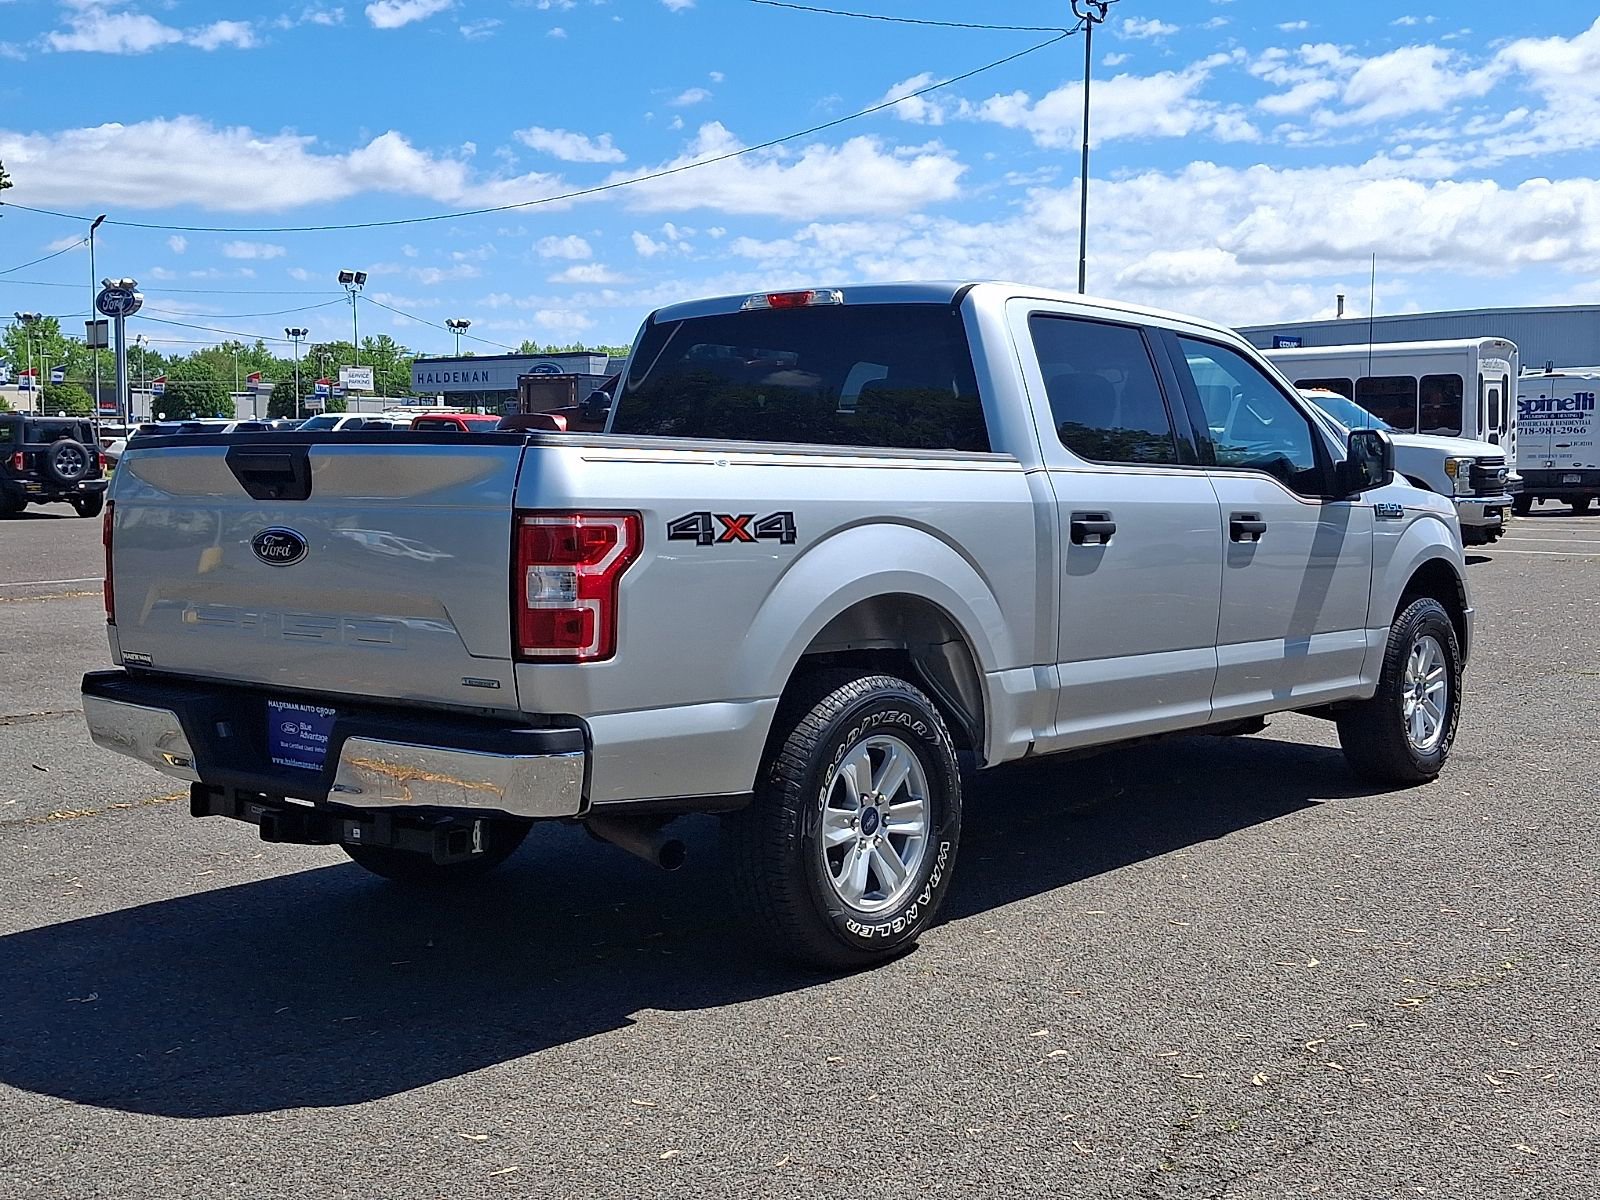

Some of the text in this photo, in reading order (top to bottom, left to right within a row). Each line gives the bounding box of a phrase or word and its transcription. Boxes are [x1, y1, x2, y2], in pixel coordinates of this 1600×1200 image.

[102, 291, 127, 311] Ford
[417, 370, 489, 385] HALDEMAN
[1517, 392, 1595, 415] Spinelli
[1517, 426, 1587, 435] 718-981-2966
[260, 534, 292, 557] Ford
[268, 700, 336, 716] HALDEMAN AUTO GROUP
[300, 722, 312, 731] Blue
[300, 731, 328, 743] Advantage
[818, 710, 929, 812] GOODYEAR
[846, 841, 950, 938] WRANGLER
